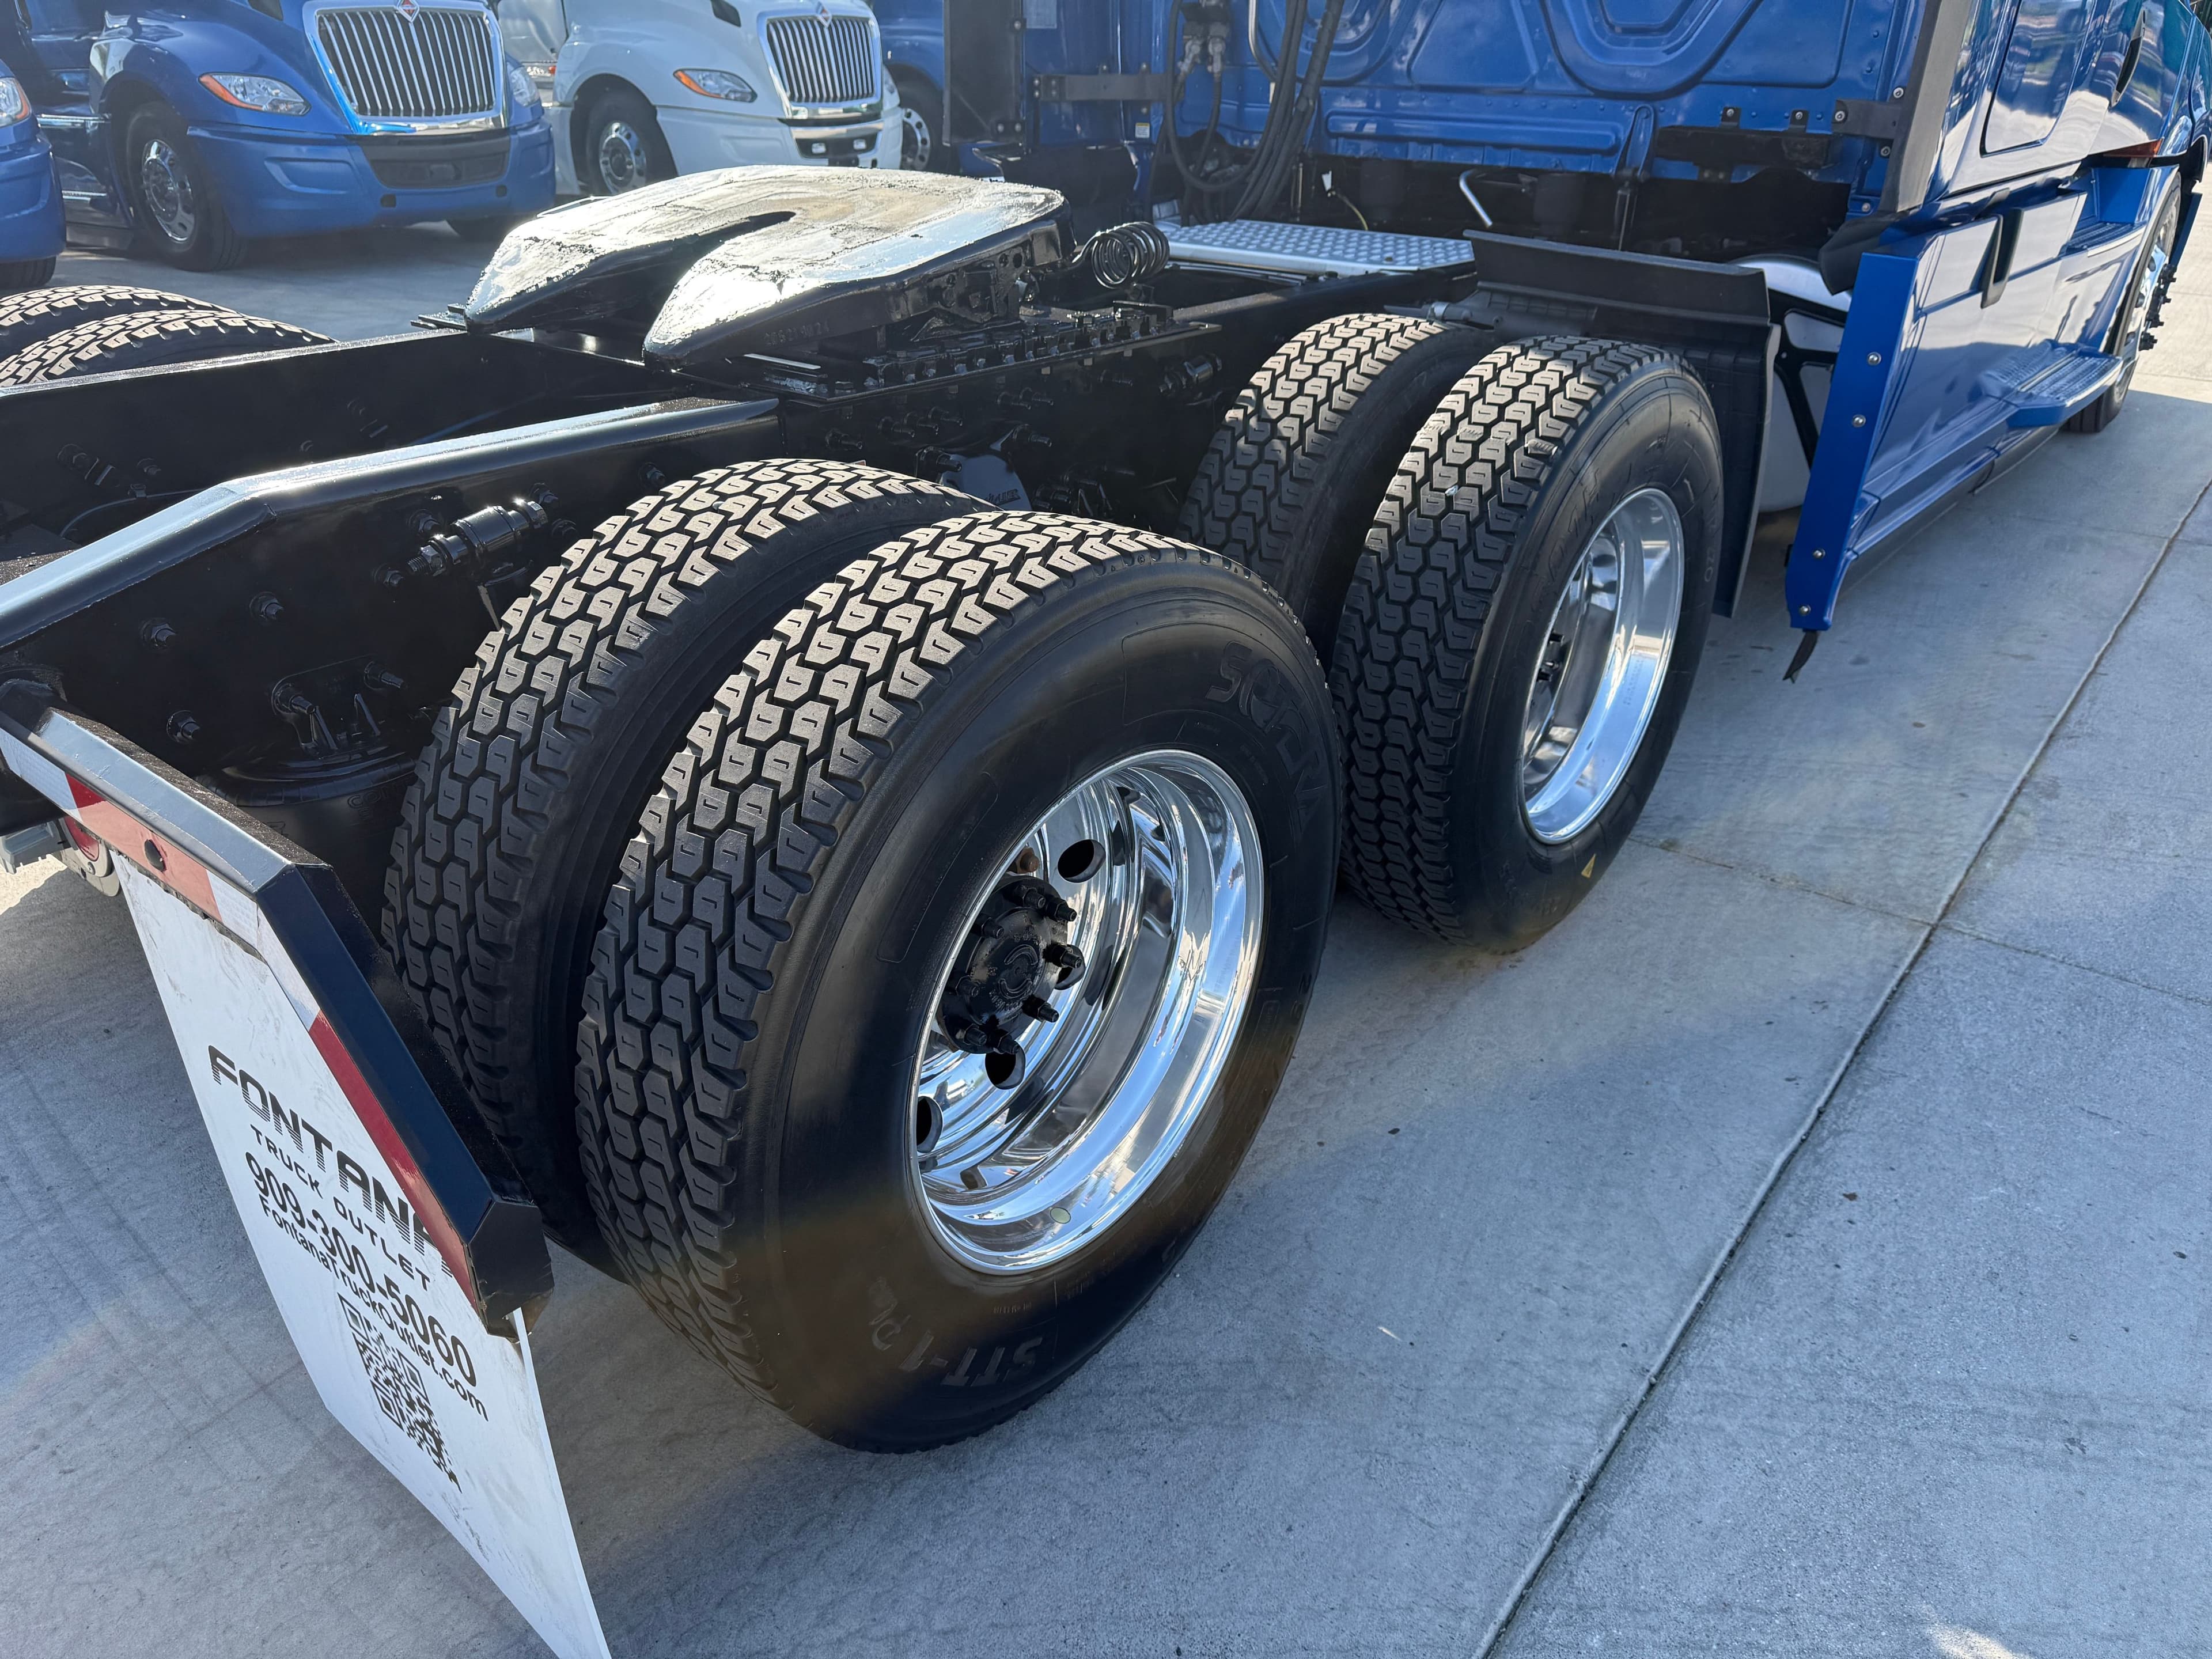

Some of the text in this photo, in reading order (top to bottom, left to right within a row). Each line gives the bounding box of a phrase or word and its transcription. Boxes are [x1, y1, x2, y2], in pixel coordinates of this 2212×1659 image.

[245, 1152, 477, 1387] 909-300-5060
[250, 1124, 430, 1291] TRUCK OUTLET
[259, 1194, 489, 1422] FontanaTruckOutlet.com
